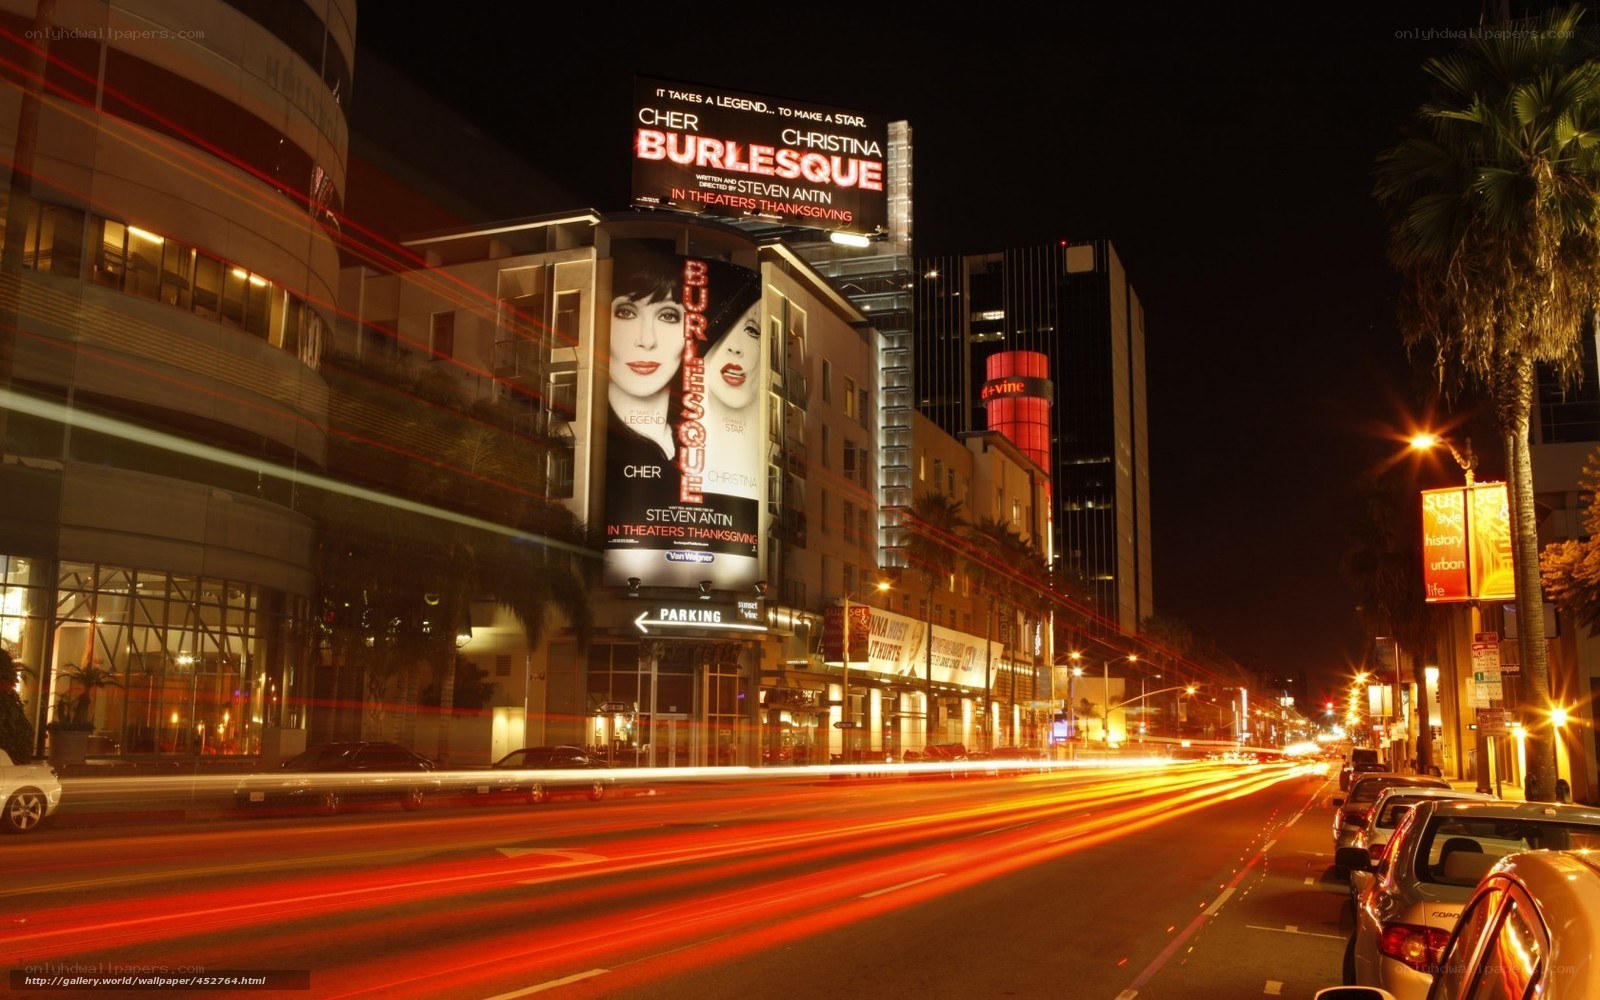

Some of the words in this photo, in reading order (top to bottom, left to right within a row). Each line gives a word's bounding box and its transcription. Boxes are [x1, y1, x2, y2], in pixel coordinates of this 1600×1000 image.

[656, 88, 665, 98] IT
[668, 90, 702, 103] TAKES
[706, 96, 714, 105] A
[716, 96, 775, 114] LEGEND...
[778, 106, 792, 118] TO
[794, 110, 822, 122] MAKE
[825, 114, 832, 122] A
[834, 114, 867, 128] STAR.
[638, 107, 699, 131] CHER
[781, 128, 882, 158] CHRISTINA
[636, 128, 883, 191] BURLESQUE
[696, 174, 723, 183] WRITTEN
[698, 181, 728, 191] DIRECTED
[737, 180, 790, 199] STEVEN
[792, 187, 832, 204] ANTIN
[672, 188, 686, 200] IN
[689, 190, 756, 210] THEATERS
[759, 200, 852, 222] THANKSGIVING
[679, 259, 709, 504] BURLESQUE
[624, 415, 666, 425] LEGEND
[624, 465, 662, 478] CHER
[708, 470, 758, 488] CHRISTINA
[1423, 493, 1464, 510] sun
[646, 508, 696, 523] STEVEN
[699, 512, 733, 527] ANTIN
[1436, 511, 1462, 526] style
[608, 525, 619, 536] IN
[623, 525, 685, 538] THEATERS
[687, 527, 758, 545] THANKSGIVING
[1425, 533, 1463, 548] history
[669, 552, 684, 560] Van
[1430, 557, 1465, 571] urban
[1427, 583, 1445, 596] life
[737, 602, 758, 610] sunset
[660, 608, 721, 623] PARKING
[744, 610, 758, 619] vine
